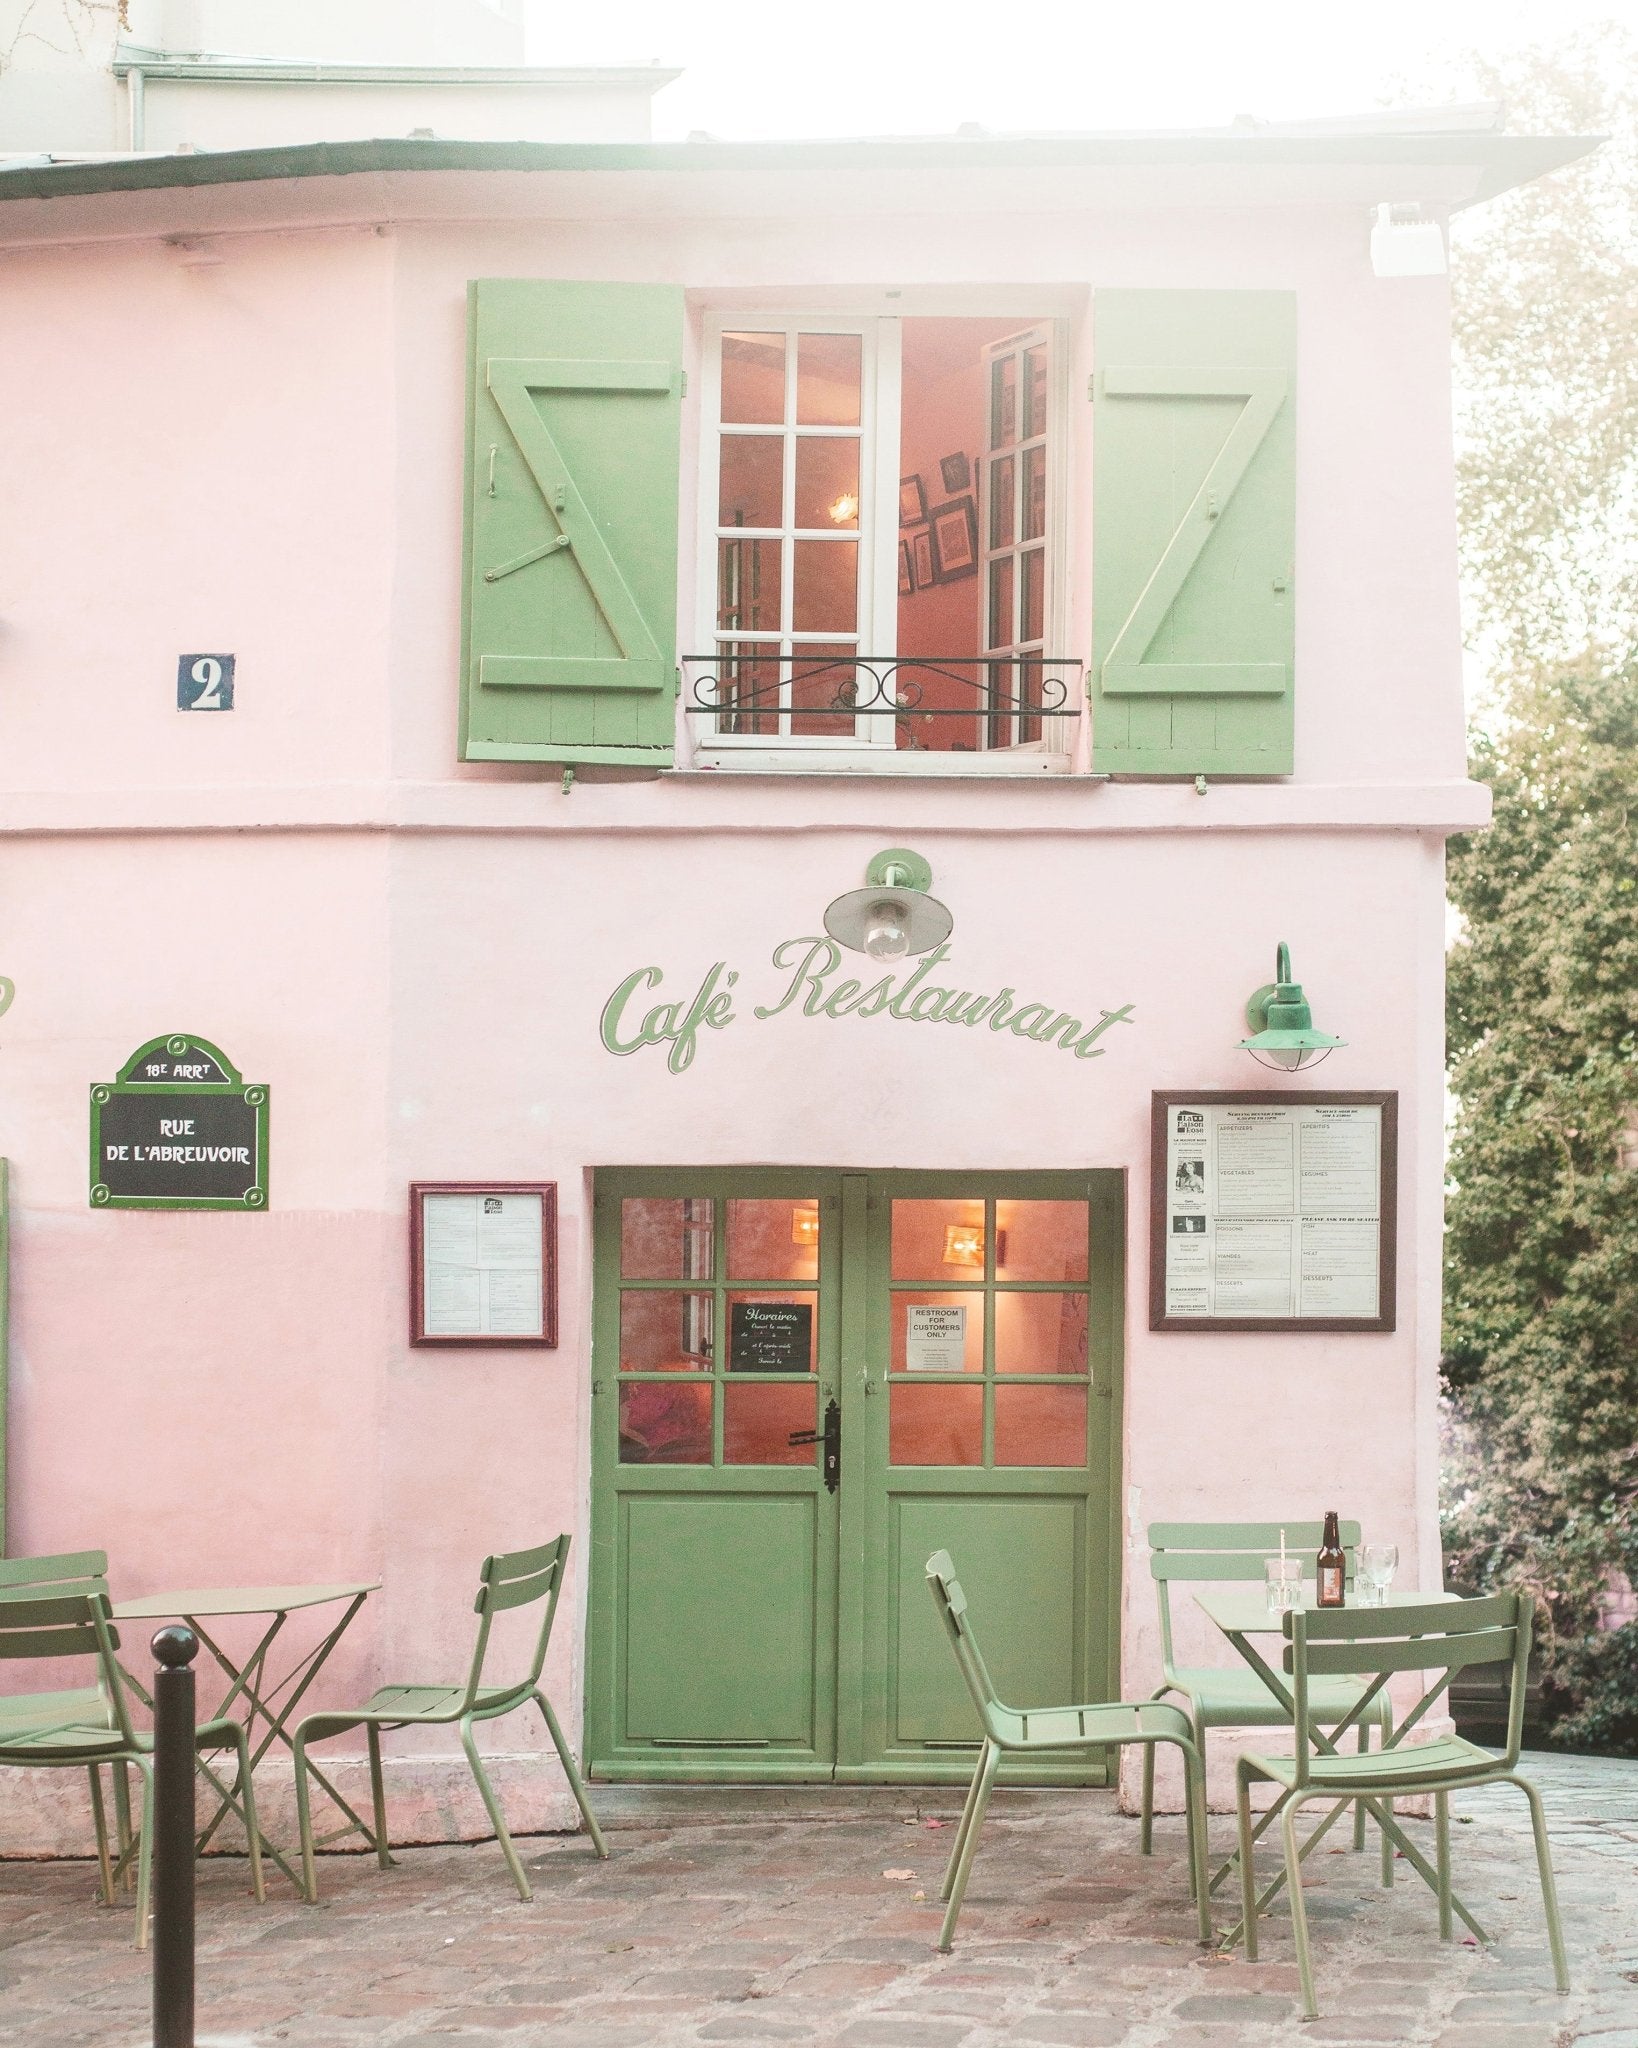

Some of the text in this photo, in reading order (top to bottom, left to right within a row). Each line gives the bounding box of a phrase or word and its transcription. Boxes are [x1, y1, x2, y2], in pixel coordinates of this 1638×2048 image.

[190, 657, 222, 708] 2
[600, 936, 1137, 1075] Café Restaurant
[160, 1119, 195, 1137] RUE
[106, 1145, 251, 1165] DE L'ABREUVOIR
[745, 1308, 798, 1321] Horaires
